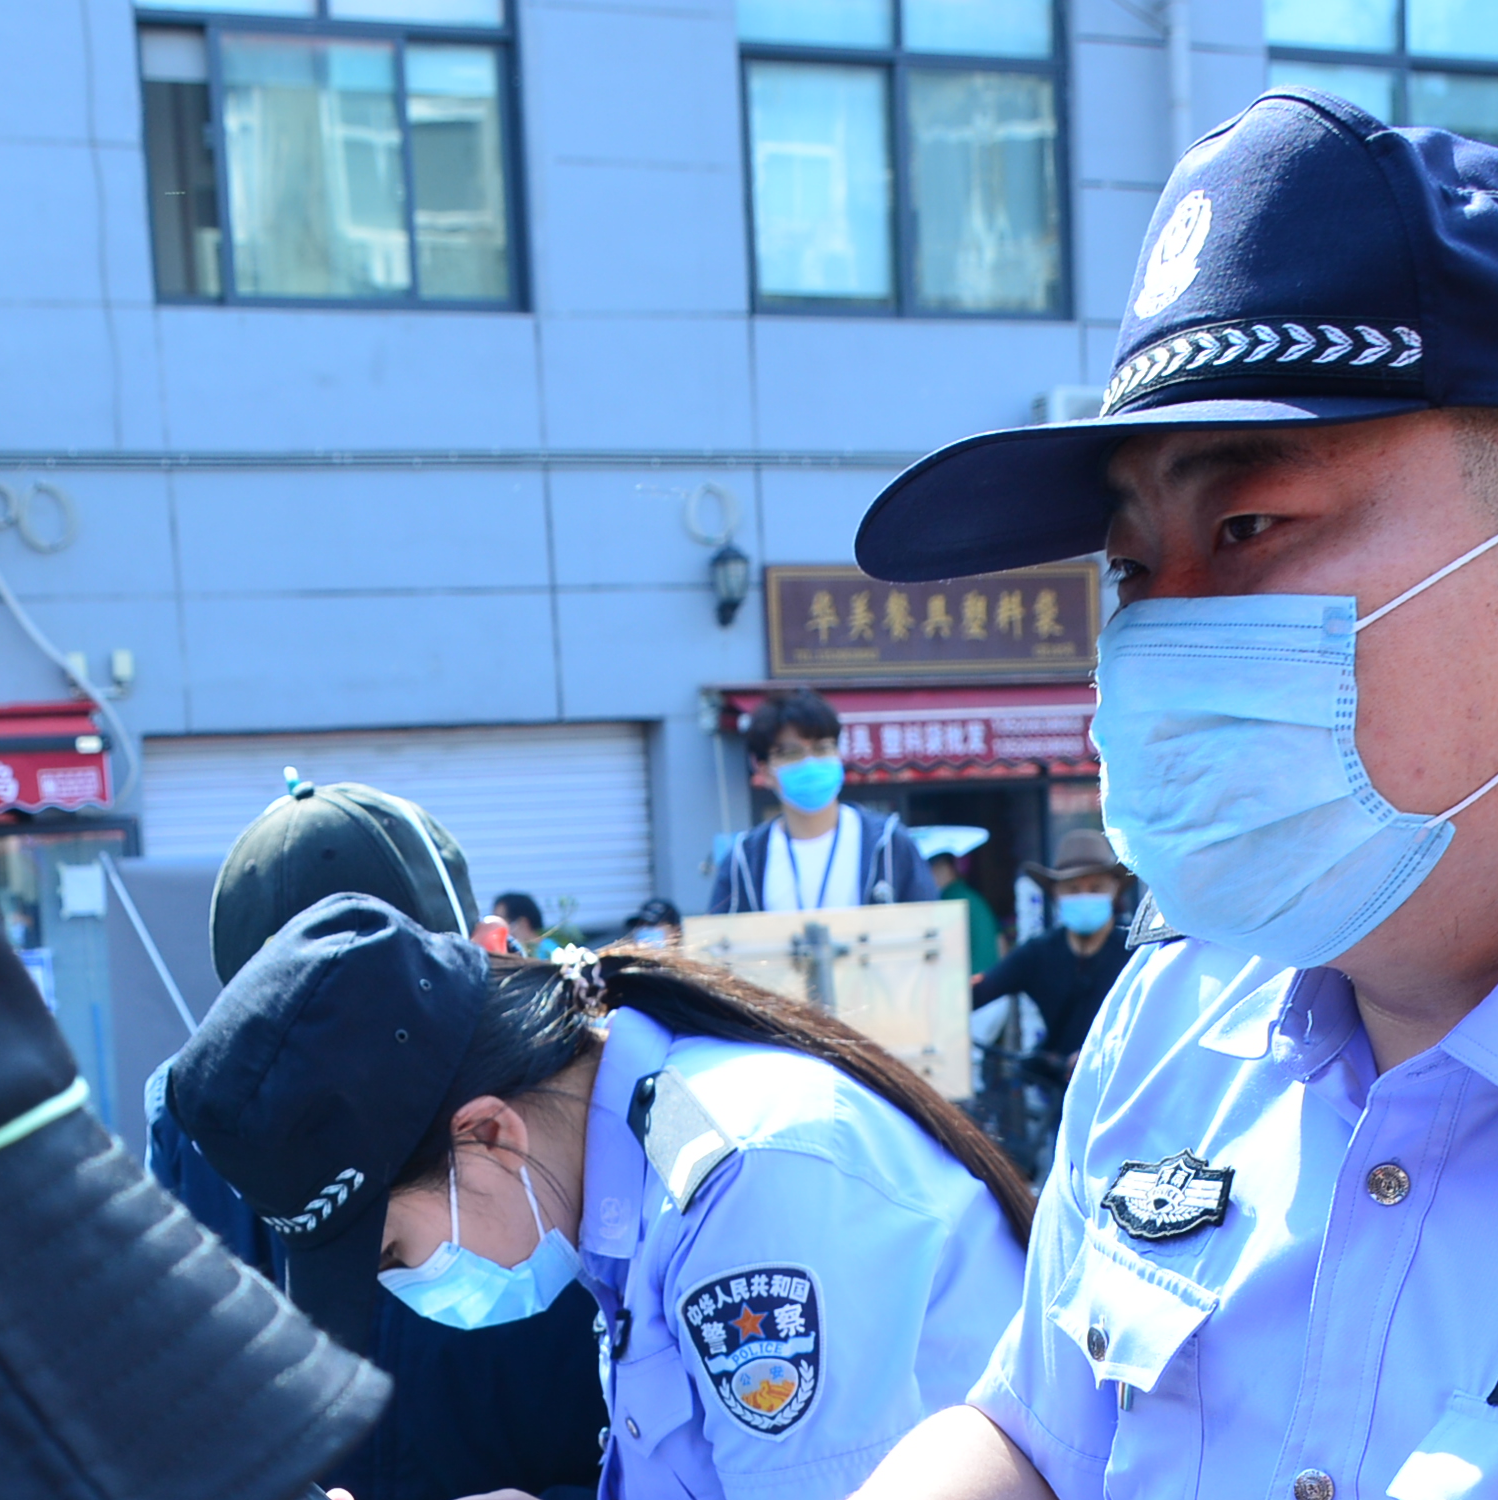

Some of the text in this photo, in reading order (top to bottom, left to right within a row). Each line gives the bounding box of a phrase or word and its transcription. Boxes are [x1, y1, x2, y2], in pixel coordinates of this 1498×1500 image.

[686, 1274, 811, 1327] 中华人民共和国
[731, 1342, 784, 1365] POLICE
